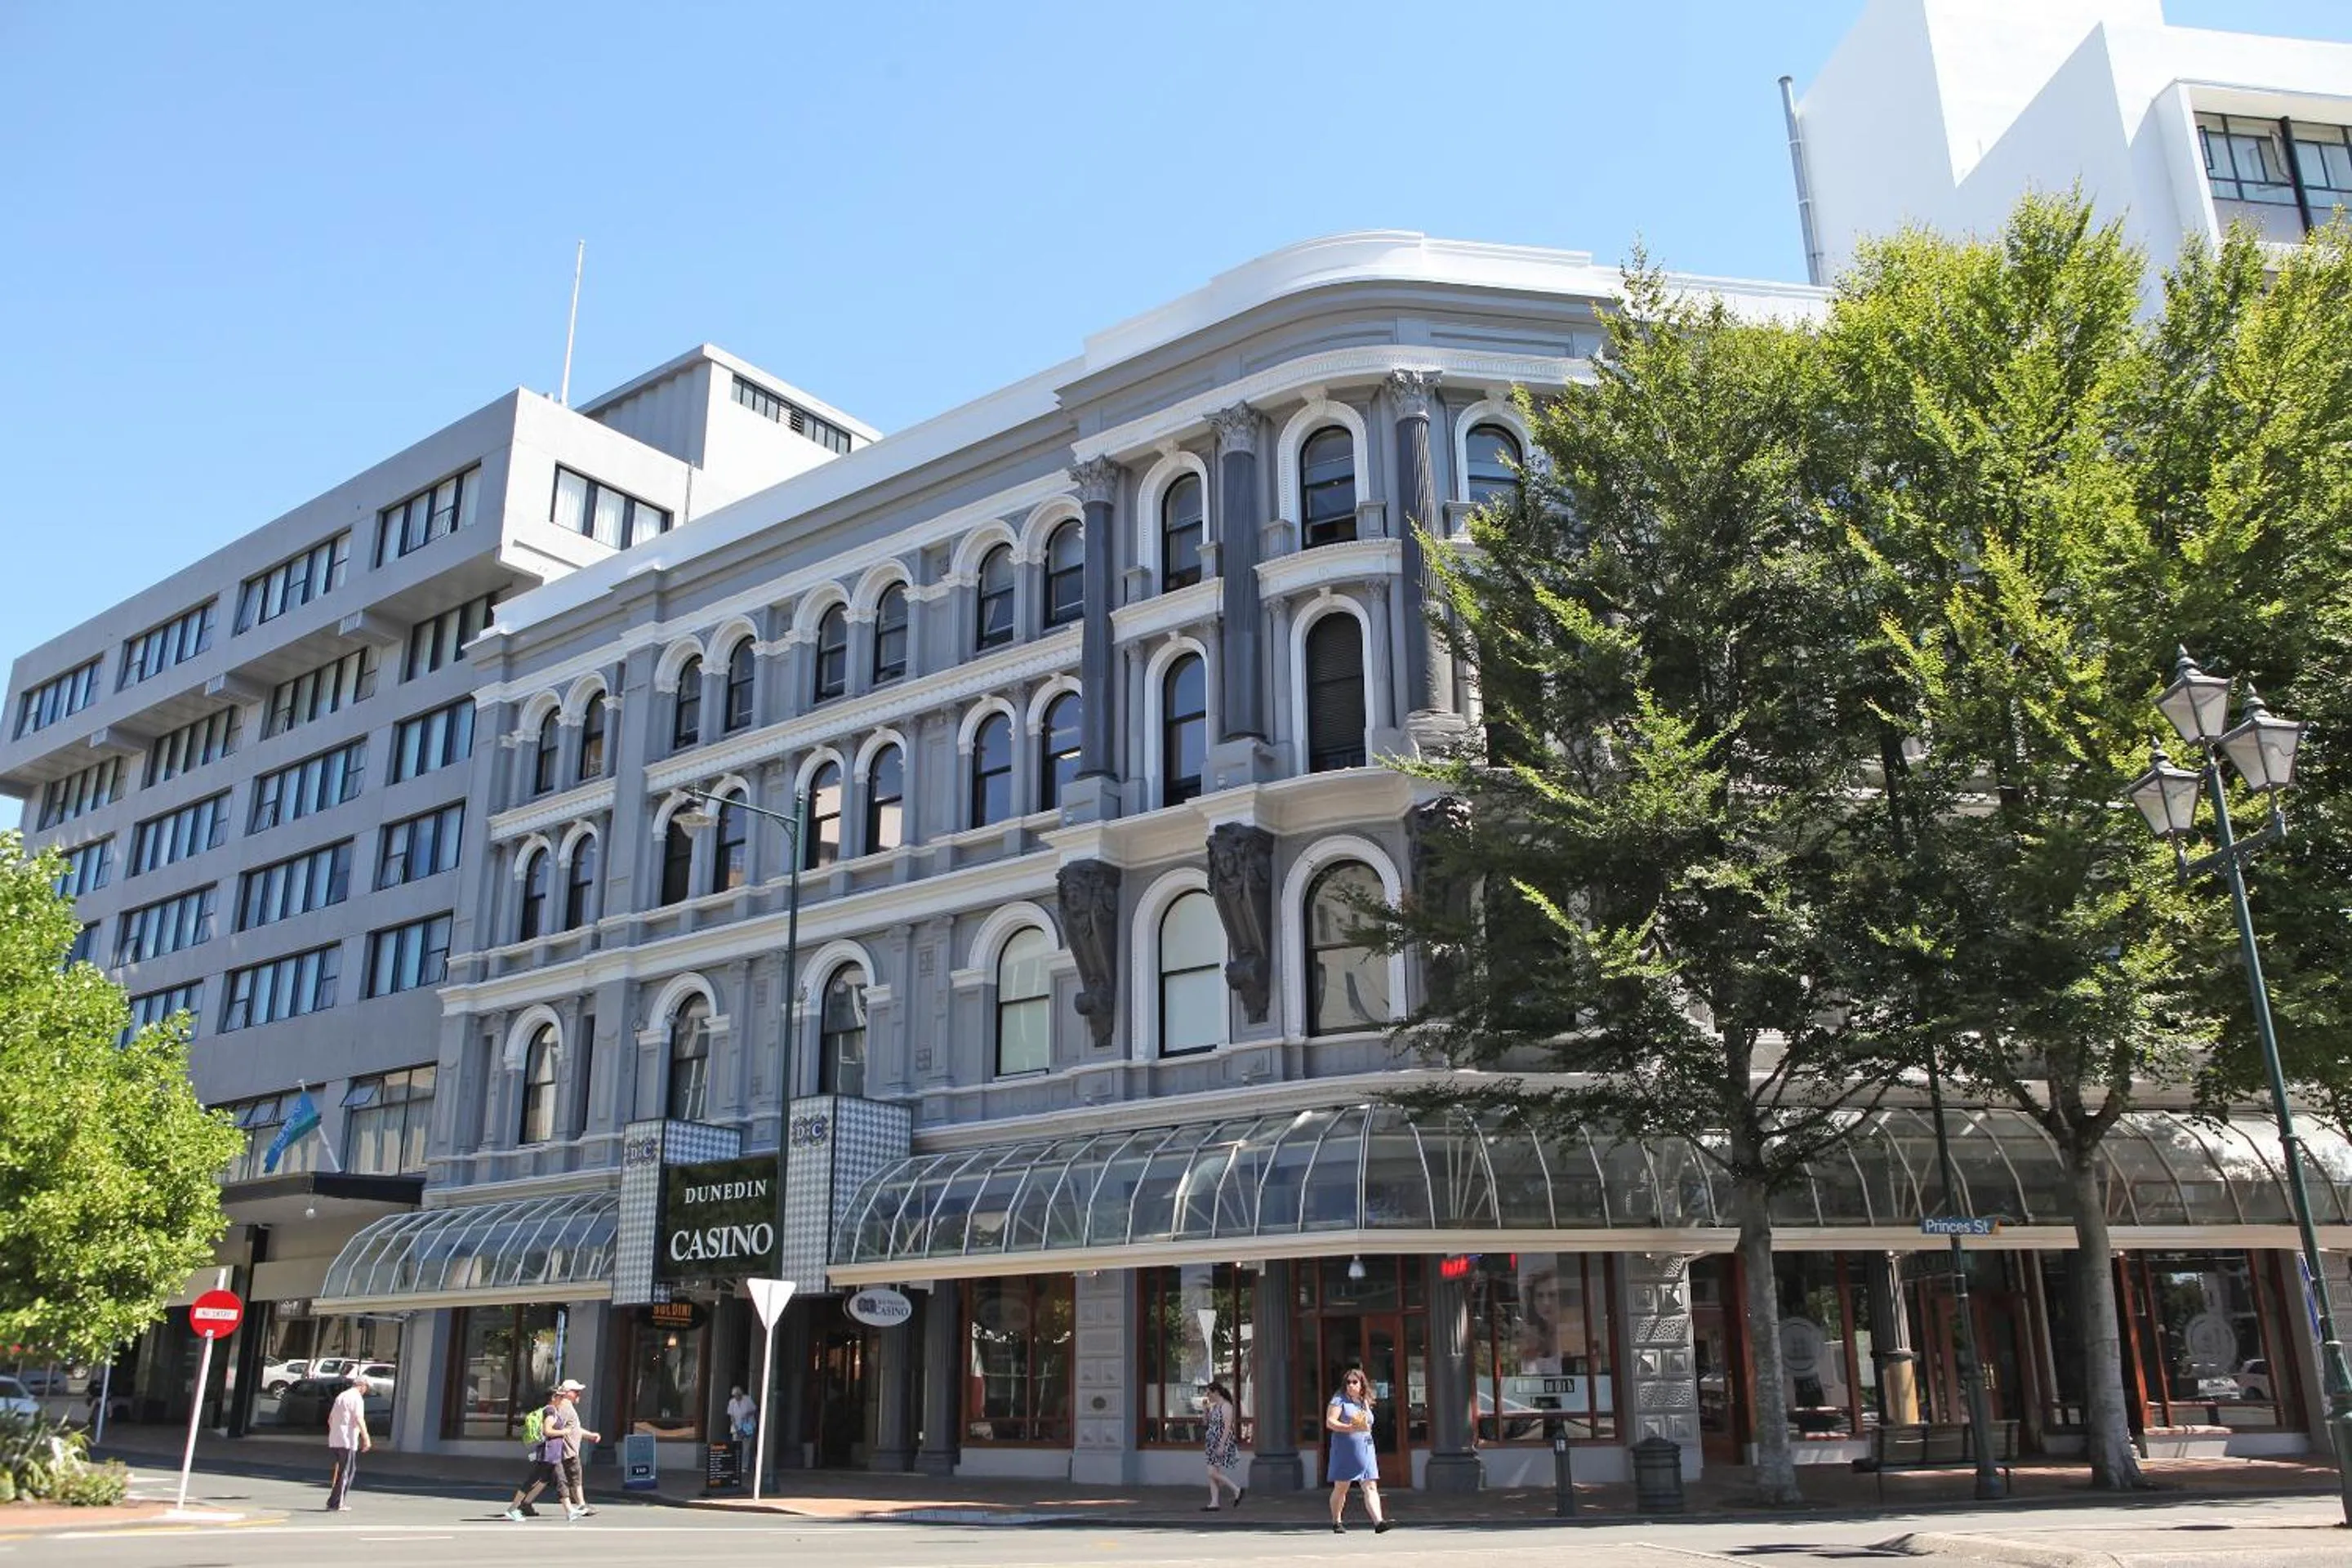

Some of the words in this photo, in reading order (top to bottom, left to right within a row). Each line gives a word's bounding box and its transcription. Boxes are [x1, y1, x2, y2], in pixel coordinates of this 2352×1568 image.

[684, 1178, 768, 1205] DUNEDIN
[1926, 1218, 1971, 1233] Princes
[1974, 1219, 1990, 1233] St
[670, 1223, 773, 1262] CASINO
